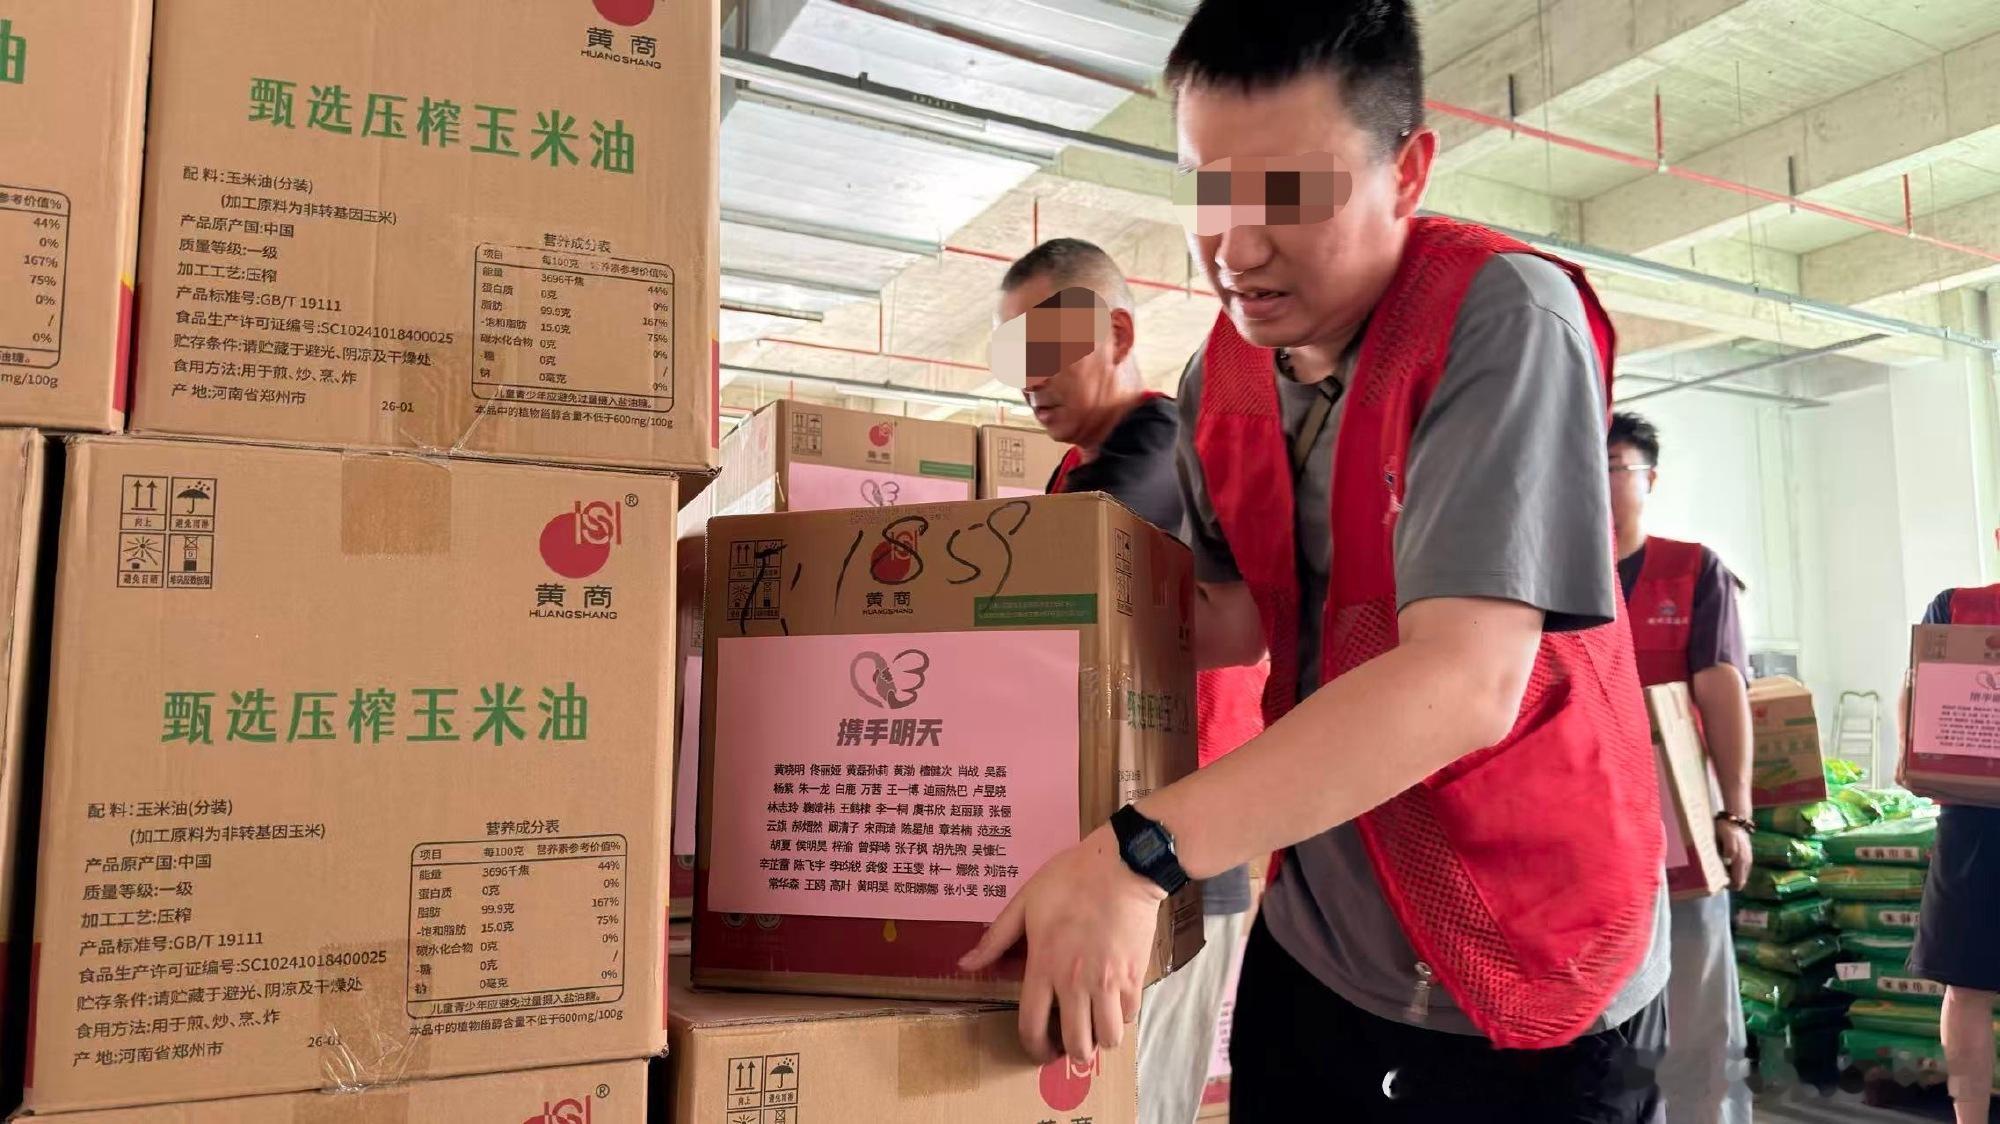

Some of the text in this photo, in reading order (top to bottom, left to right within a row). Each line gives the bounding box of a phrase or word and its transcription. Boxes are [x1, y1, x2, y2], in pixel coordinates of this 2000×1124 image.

[587, 27, 657, 58] 黄商
[581, 50, 661, 69] HUANGSHANG
[248, 77, 634, 174] 甄选压榨玉米油
[220, 194, 397, 225] (加工原料为非转基因玉米)
[33, 217, 60, 230] 44%
[180, 214, 294, 238] 产品原产国:中国
[39, 237, 59, 249] 0%
[178, 238, 278, 260] 质量等级:一级
[24, 254, 58, 268] 167%
[29, 274, 57, 286] 75%
[177, 262, 277, 283] 加工工艺:压榨
[648, 286, 668, 296] 44%
[35, 294, 55, 305] 0%
[300, 296, 341, 312] 19111
[653, 303, 668, 311] 0%
[642, 317, 668, 327] 167%
[32, 333, 52, 343] 0%
[648, 334, 667, 343] 75%
[653, 351, 668, 359] 0%
[653, 383, 668, 392] 0%
[382, 400, 414, 413] 26-01
[535, 583, 612, 609] 黄商
[866, 591, 911, 607] 黄商
[529, 609, 618, 620] HUANGSHANG
[161, 682, 588, 746] 甄选压榨玉米油
[836, 718, 944, 747] 携手明天
[774, 764, 805, 776] 黄晓明
[810, 764, 841, 776] 佟丽娅
[959, 765, 979, 777] 肖战
[985, 766, 1007, 778] 吴磊
[798, 783, 830, 794] 朱一龙
[835, 783, 856, 795] 白鹿
[861, 783, 882, 795] 万茜
[887, 784, 919, 795] 王一博
[924, 784, 968, 797] 迪丽热巴
[767, 802, 799, 813] 林志玲
[130, 823, 325, 846] (加工原料为非转基因玉米)
[486, 819, 560, 836] 营养成分表
[939, 824, 972, 836] 章若楠
[977, 825, 1012, 837] 范丞丞
[420, 849, 442, 860] 项目
[483, 846, 525, 857] 每100克
[770, 840, 791, 851] 胡夏
[895, 842, 928, 854] 张子枫
[85, 854, 211, 873] 产品原产国:中国
[419, 860, 620, 880] 能量 3696千焦 44%
[794, 859, 825, 871] 陈飞宇
[929, 863, 952, 875] 林一
[984, 864, 1019, 877] 刘浩存
[82, 881, 193, 900] 质量等级:一级
[418, 879, 620, 900] 蛋白质 0克 0%
[417, 897, 620, 918] 脂肪 99.9克 167%
[81, 907, 192, 929] 加工工艺:压榨
[481, 921, 514, 934] 15.0克
[597, 915, 619, 925] 75%
[218, 932, 263, 947] 19111
[480, 941, 498, 952] 0克
[602, 934, 619, 943] 0%
[480, 959, 498, 971] 0克
[479, 978, 508, 990] 0毫克
[601, 970, 618, 979] 0%
